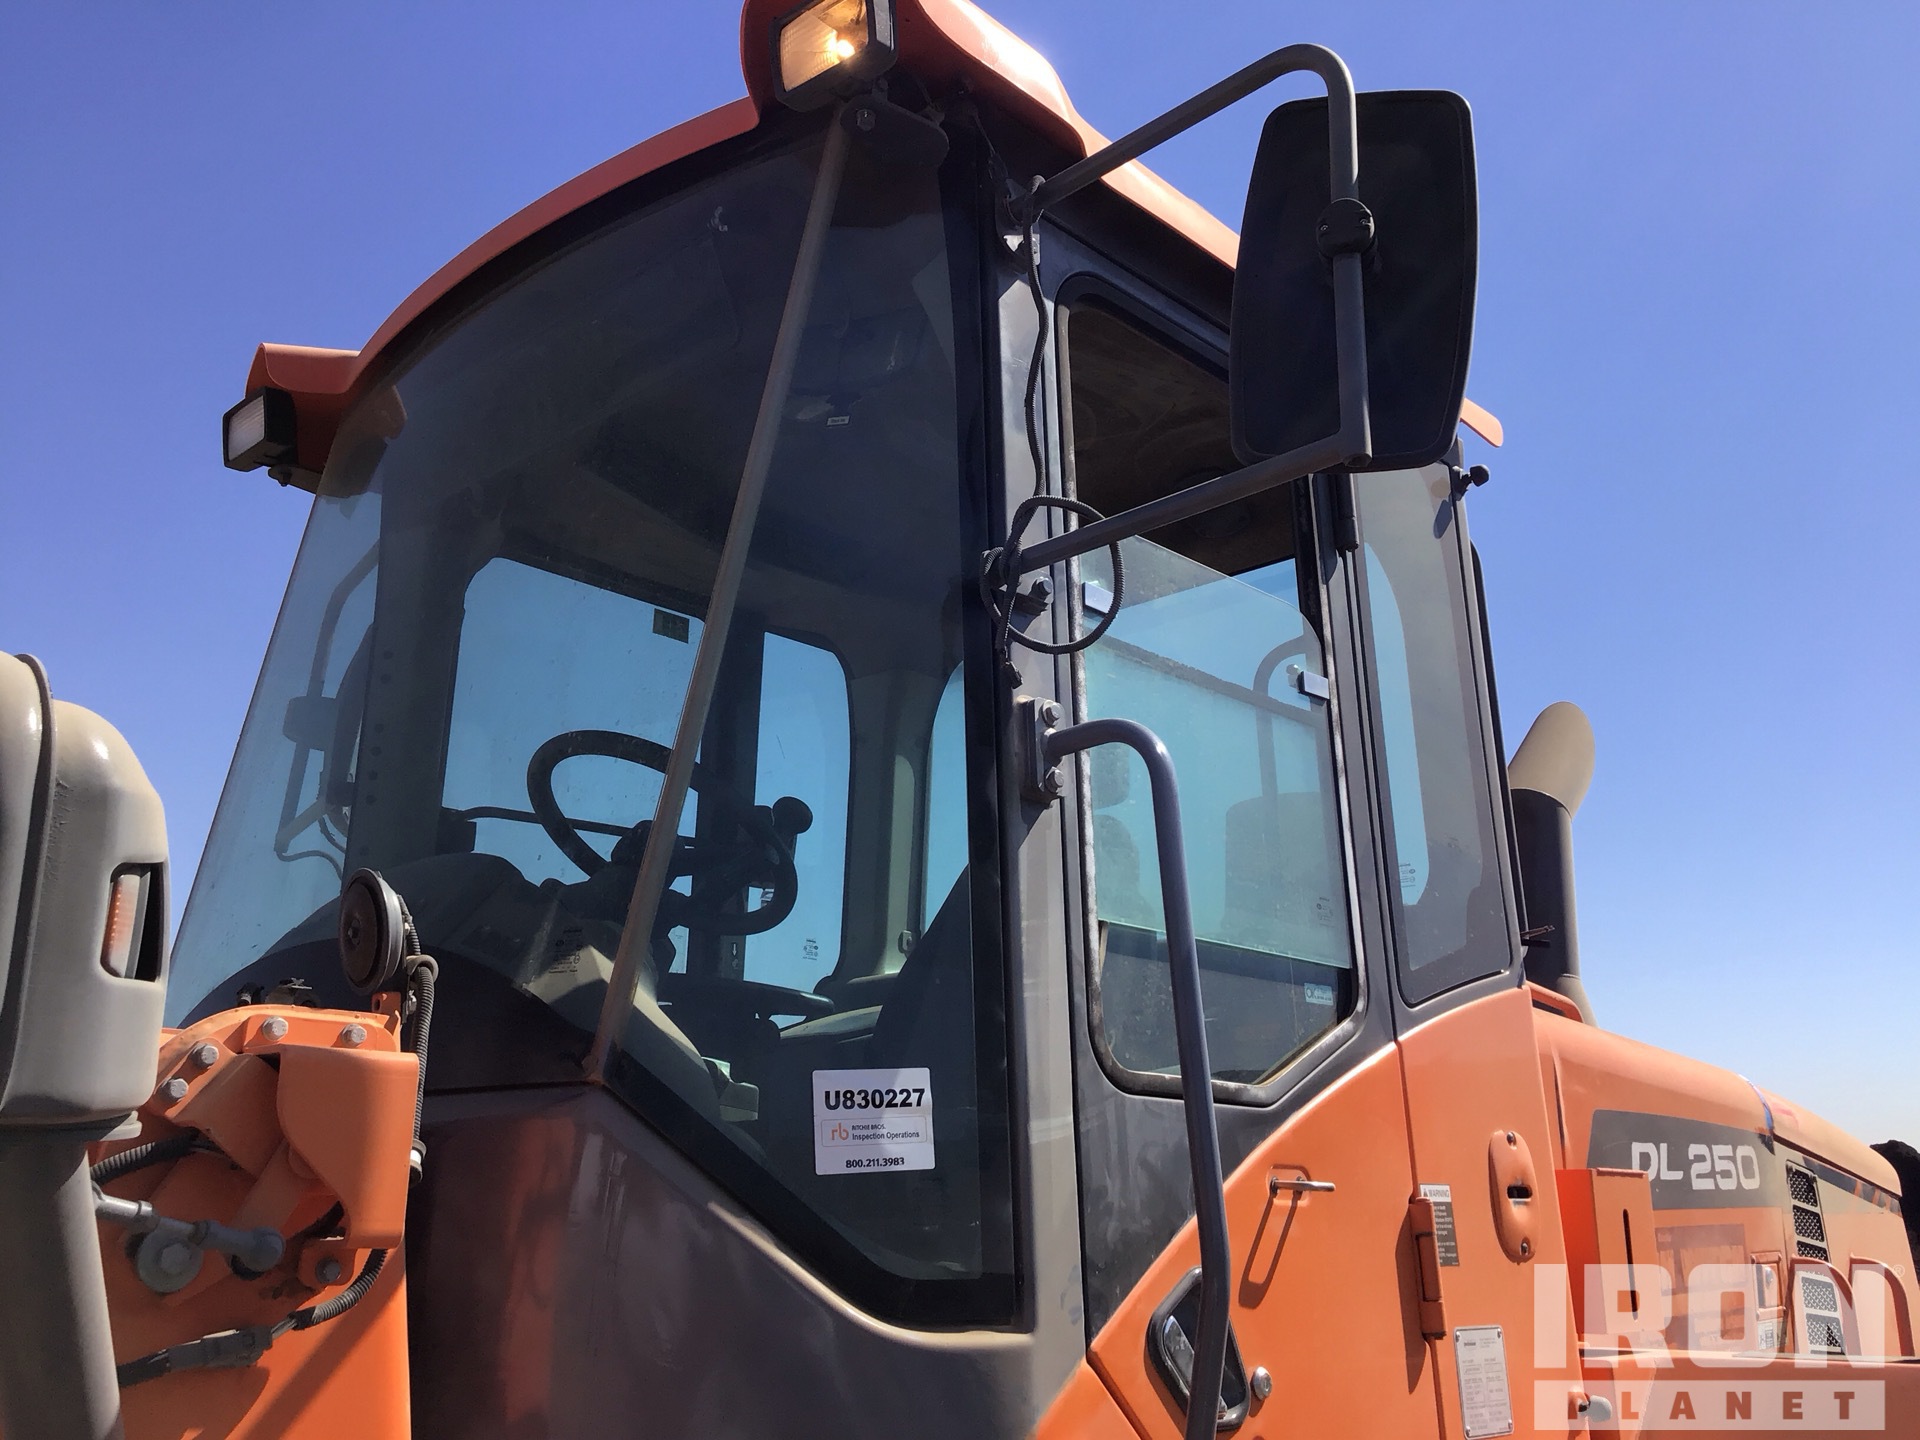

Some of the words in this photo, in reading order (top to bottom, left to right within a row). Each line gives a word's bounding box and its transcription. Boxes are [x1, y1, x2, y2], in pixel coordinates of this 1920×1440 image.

[824, 1088, 925, 1110] U830227
[852, 1132, 885, 1141] Inspection
[886, 1130, 920, 1140] Operations
[845, 1157, 905, 1168] 800.211.3983
[1631, 1142, 1684, 1182] DL
[1688, 1143, 1760, 1190] 250
[1428, 1189, 1450, 1198] WARNING
